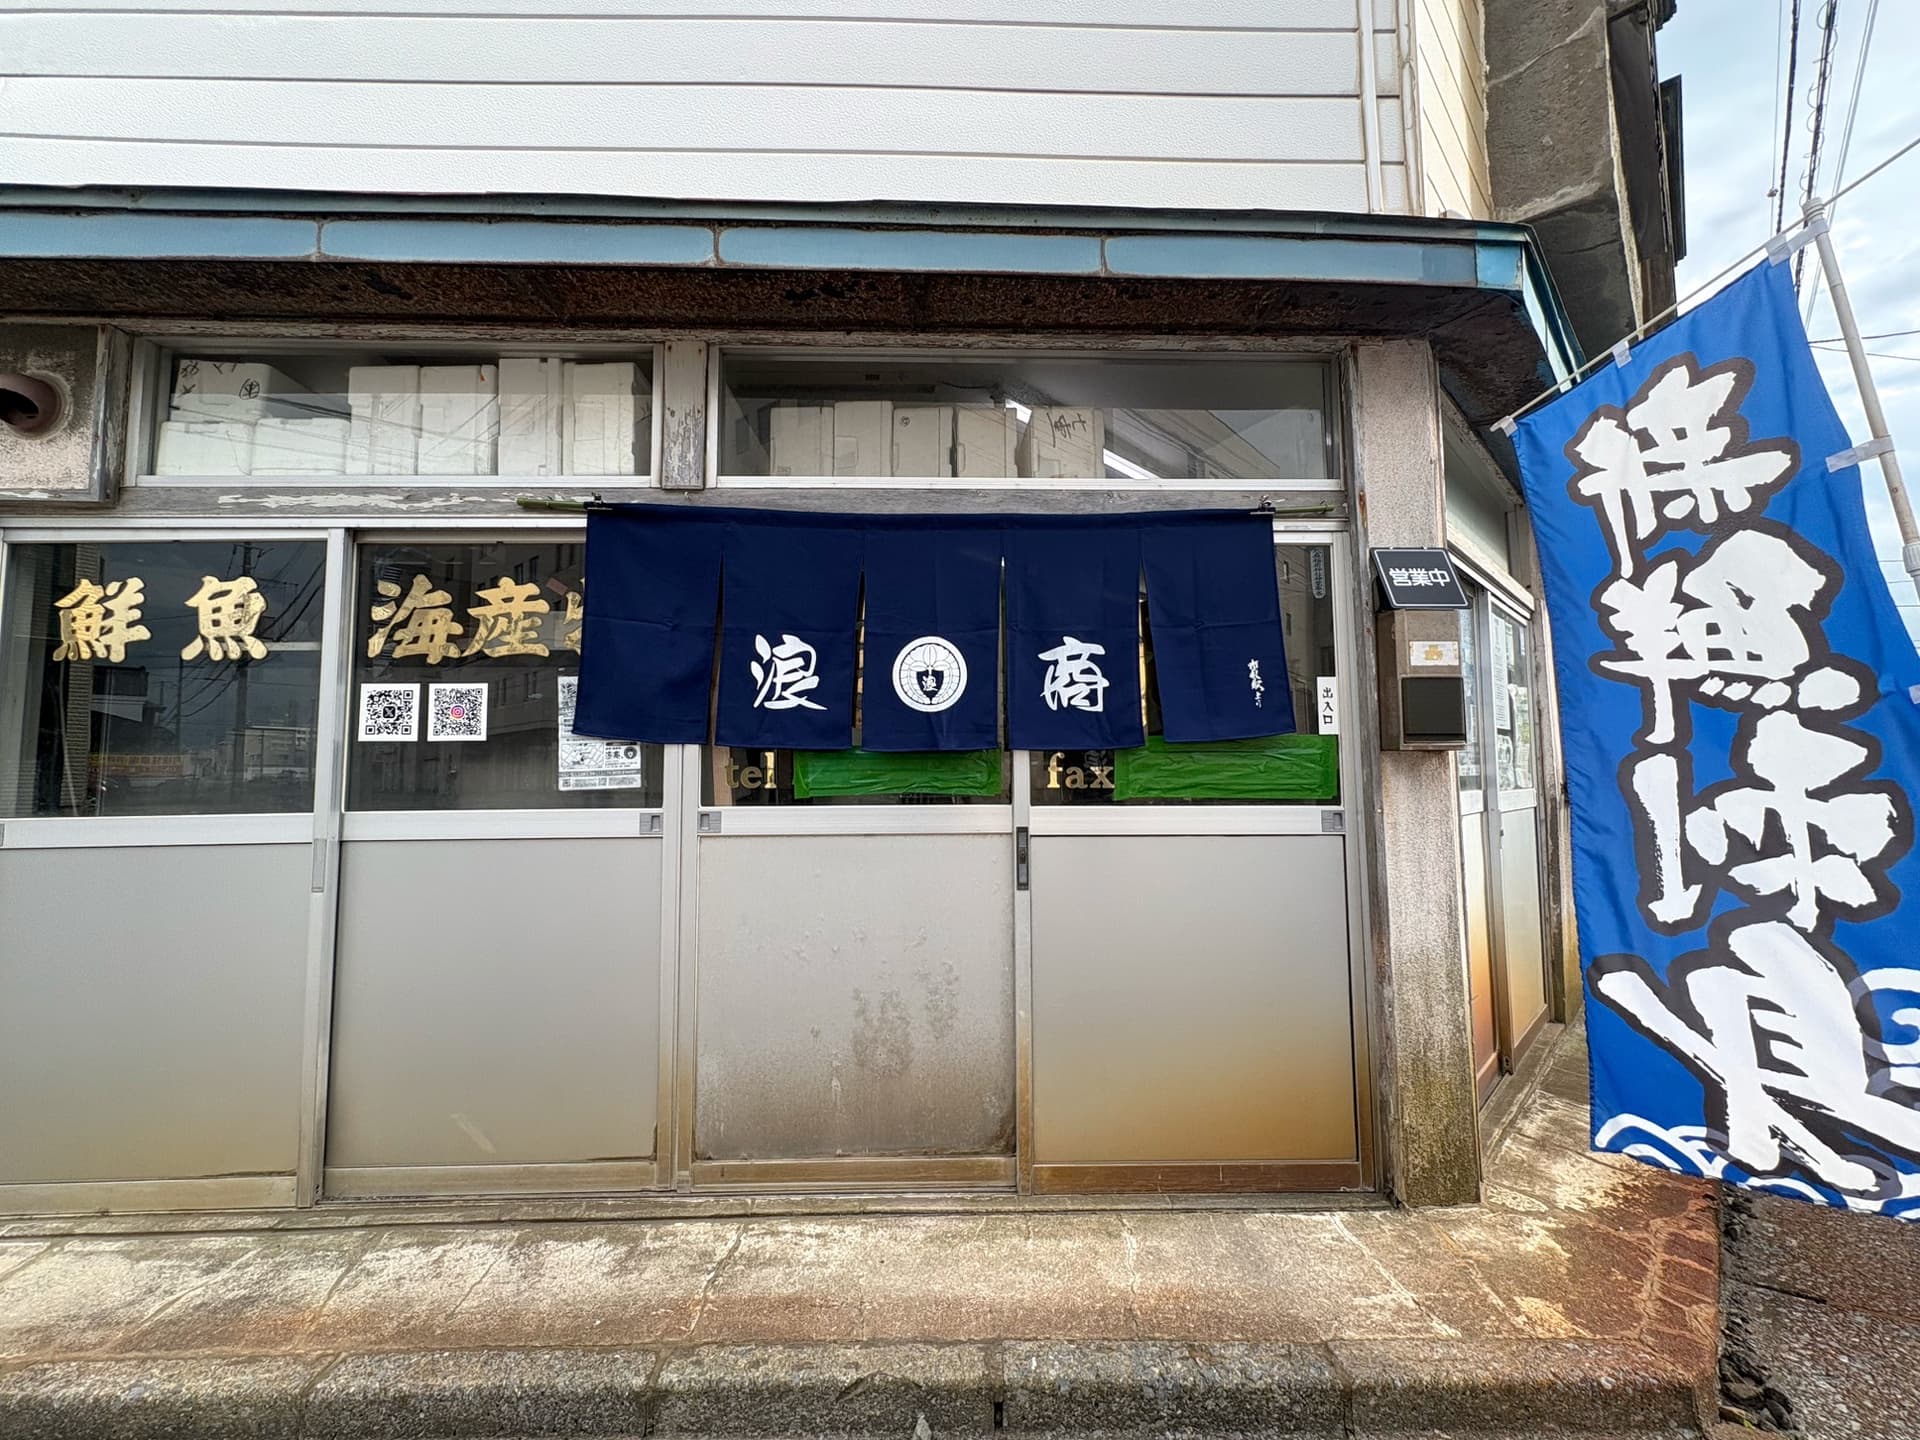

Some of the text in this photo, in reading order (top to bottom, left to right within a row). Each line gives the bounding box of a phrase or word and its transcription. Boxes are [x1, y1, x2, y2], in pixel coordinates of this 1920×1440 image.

[1389, 567, 1450, 587] 営業中
[53, 575, 268, 663] 鮮魚
[1322, 686, 1334, 725] 出入口
[725, 751, 777, 789] tel
[1046, 751, 1115, 789] fax
